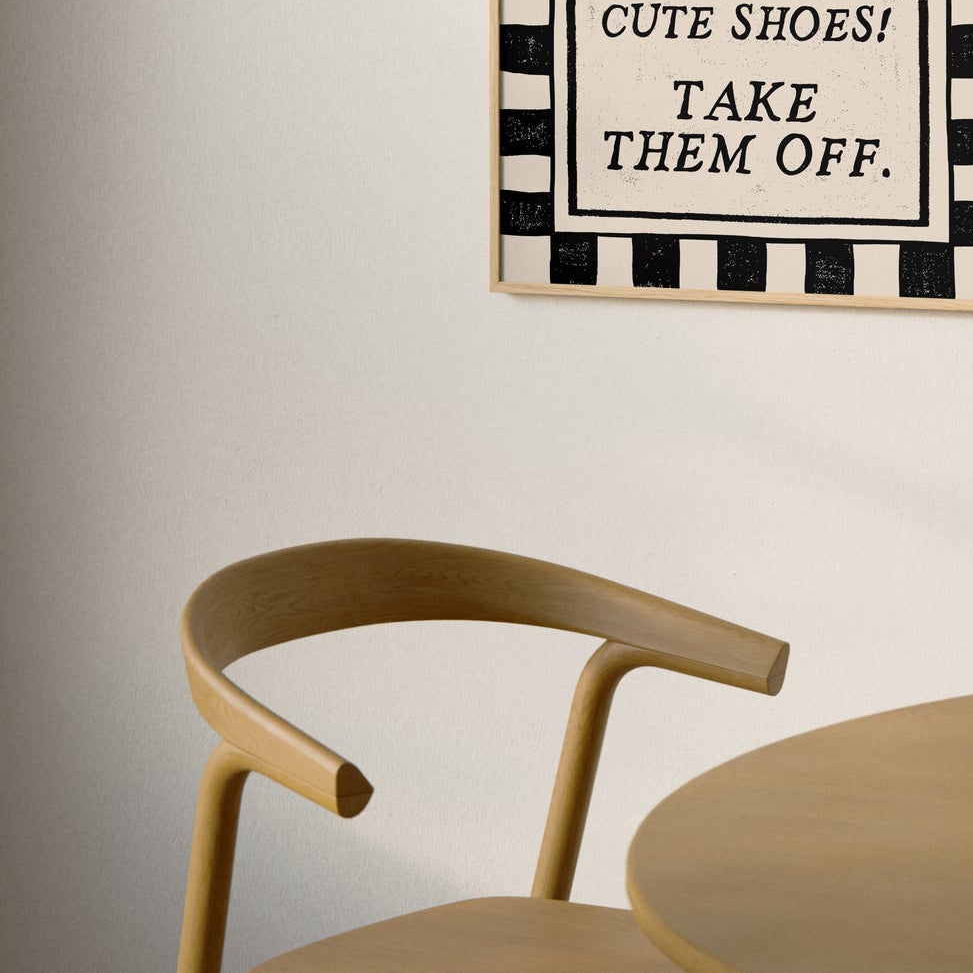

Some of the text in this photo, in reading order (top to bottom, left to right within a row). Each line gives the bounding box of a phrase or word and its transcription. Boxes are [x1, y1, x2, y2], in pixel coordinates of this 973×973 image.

[601, 2, 892, 43] CUTE SHOES!
[673, 80, 818, 123] TAKE
[603, 130, 891, 178] THEM OFF.
